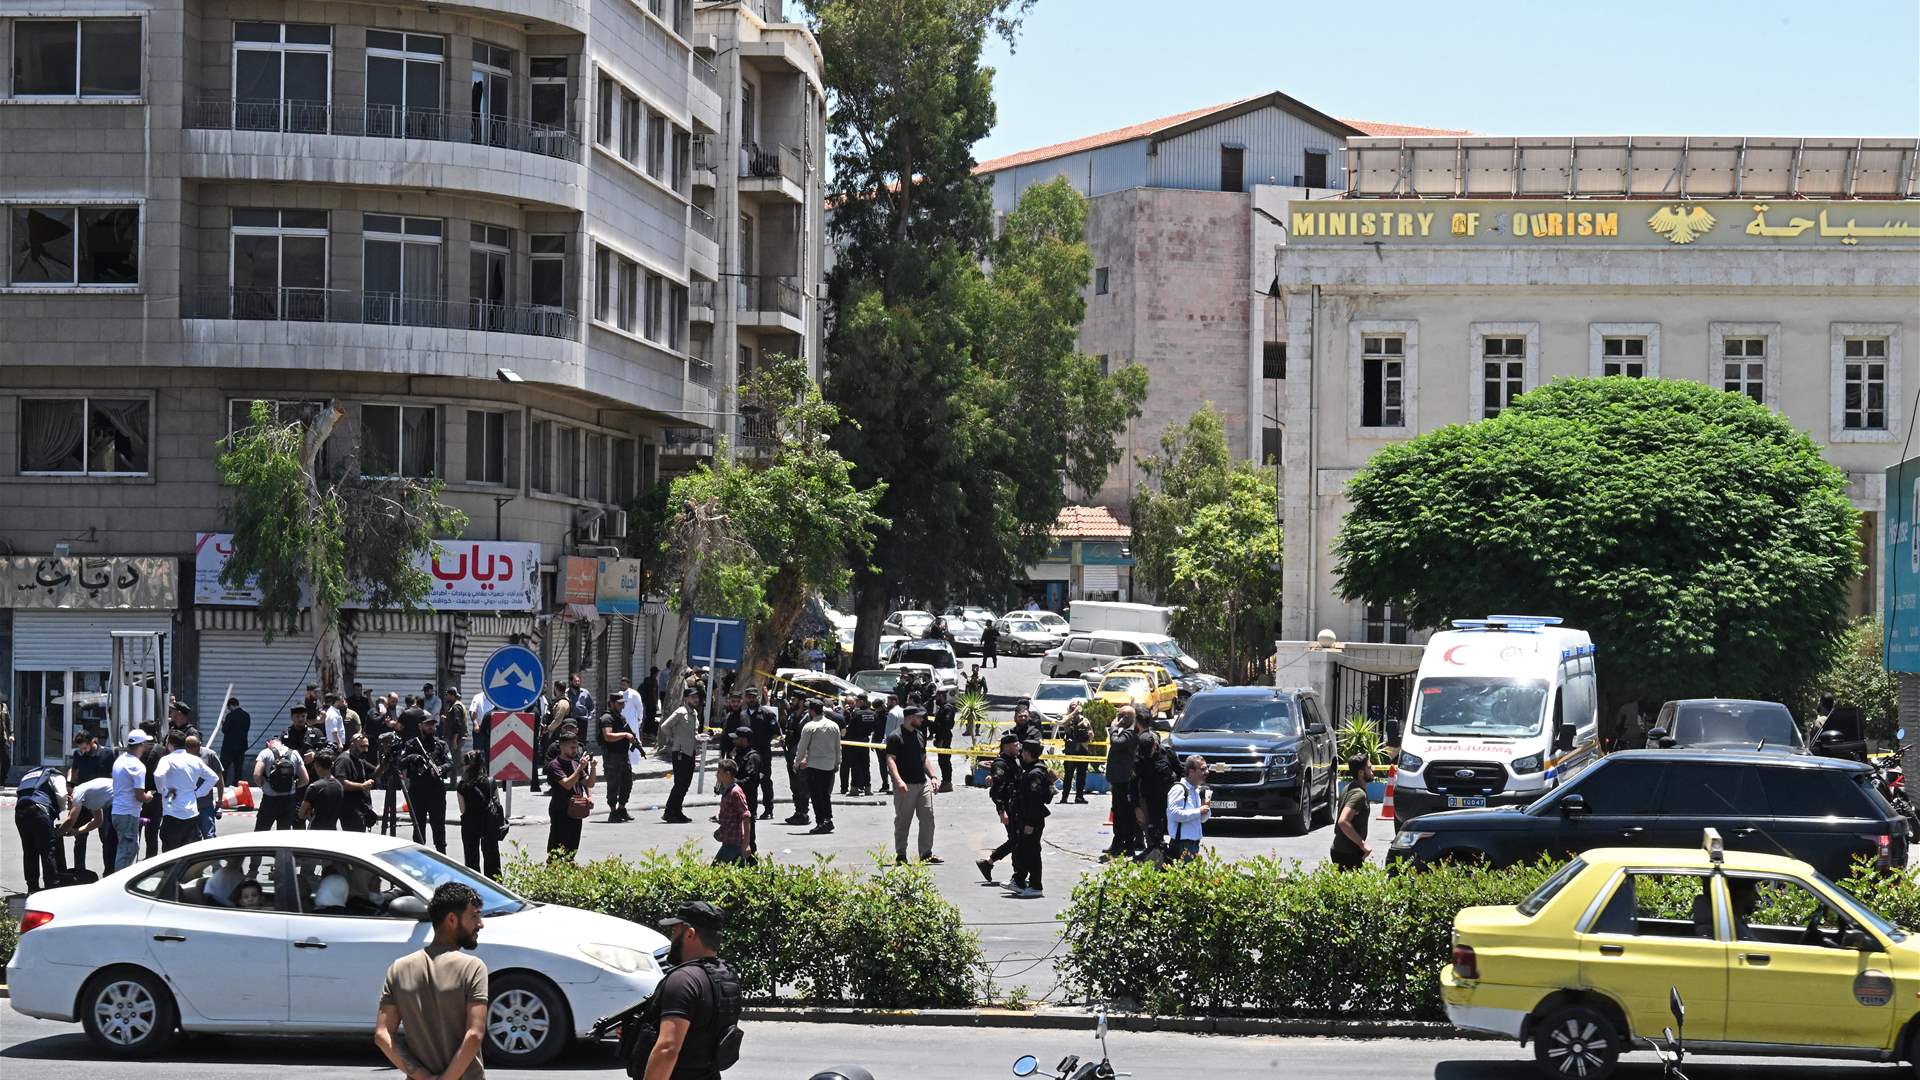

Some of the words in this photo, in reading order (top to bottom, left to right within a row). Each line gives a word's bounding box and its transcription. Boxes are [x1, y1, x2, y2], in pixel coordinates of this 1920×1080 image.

[1292, 212, 1434, 236] MINISTRY
[1451, 212, 1480, 236] OF
[1489, 212, 1618, 237] OURISM
[1745, 203, 1920, 246] سياحة
[431, 544, 514, 591] دياب
